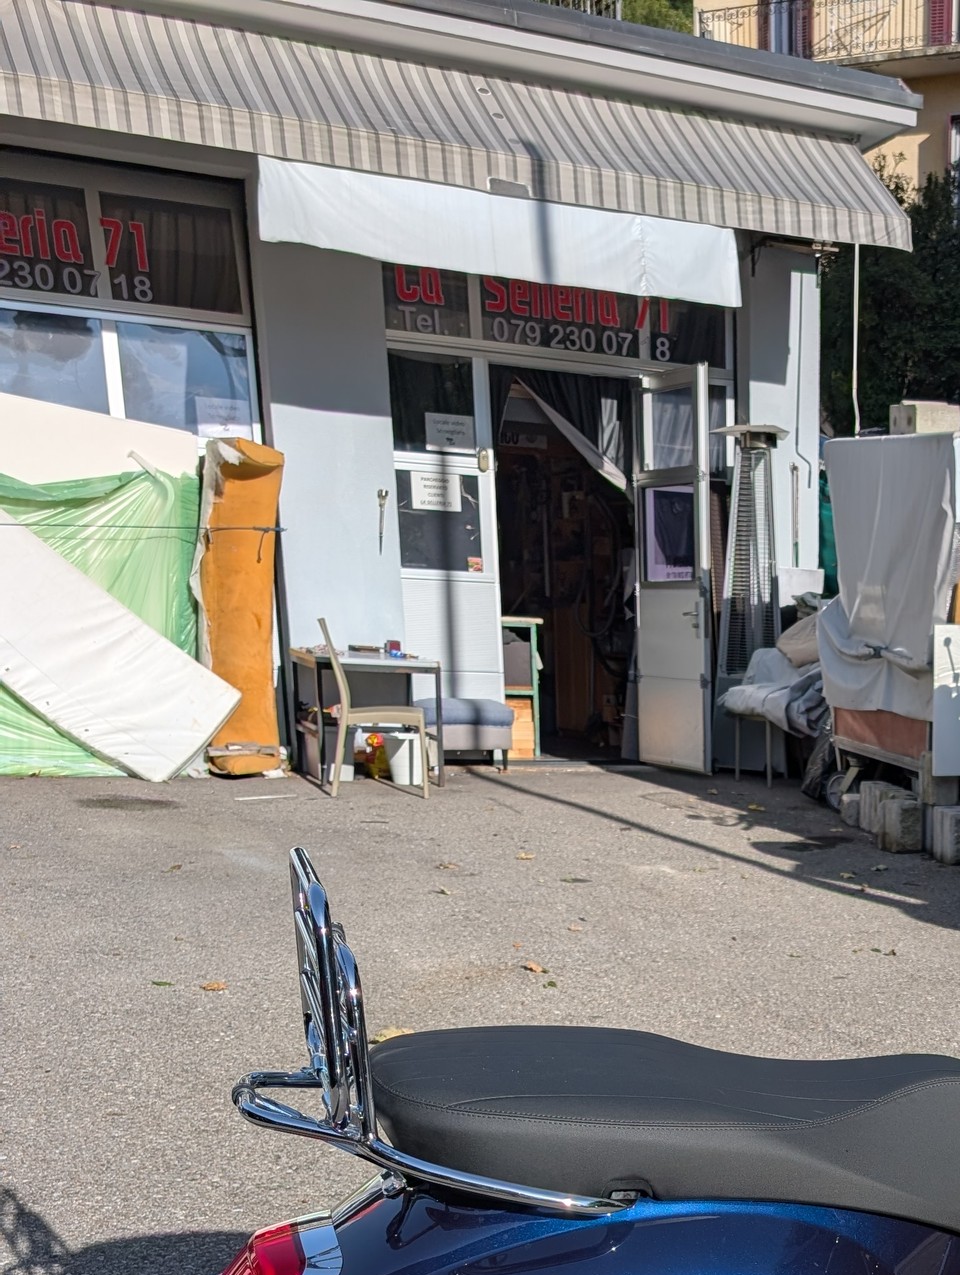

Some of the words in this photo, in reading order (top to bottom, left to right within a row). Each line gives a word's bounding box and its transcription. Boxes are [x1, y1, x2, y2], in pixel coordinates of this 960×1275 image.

[100, 217, 149, 272] 71
[63, 267, 100, 297] 07
[113, 274, 153, 302] 18
[398, 305, 449, 335] Tel.
[493, 317, 541, 346] 079
[550, 324, 595, 352] 230
[602, 330, 633, 356] 07
